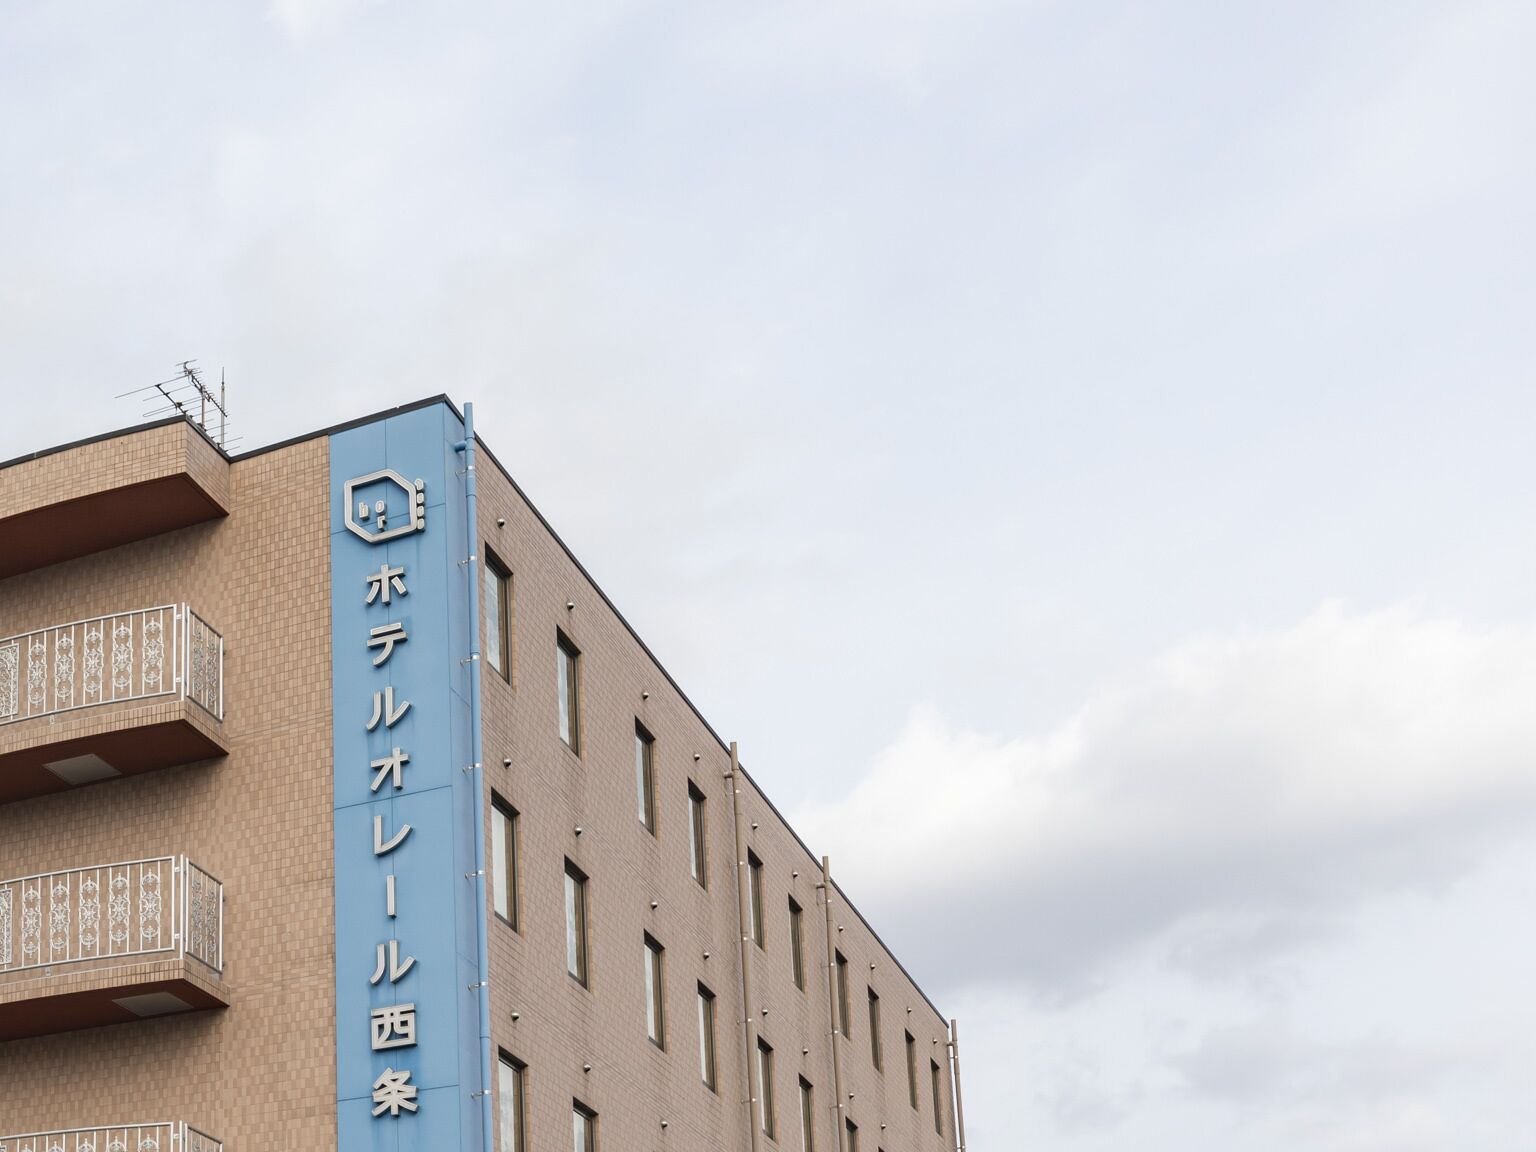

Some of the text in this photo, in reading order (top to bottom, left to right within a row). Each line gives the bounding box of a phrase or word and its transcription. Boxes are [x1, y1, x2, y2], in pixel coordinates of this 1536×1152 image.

[365, 563, 420, 1120] ホテルオレール西条
